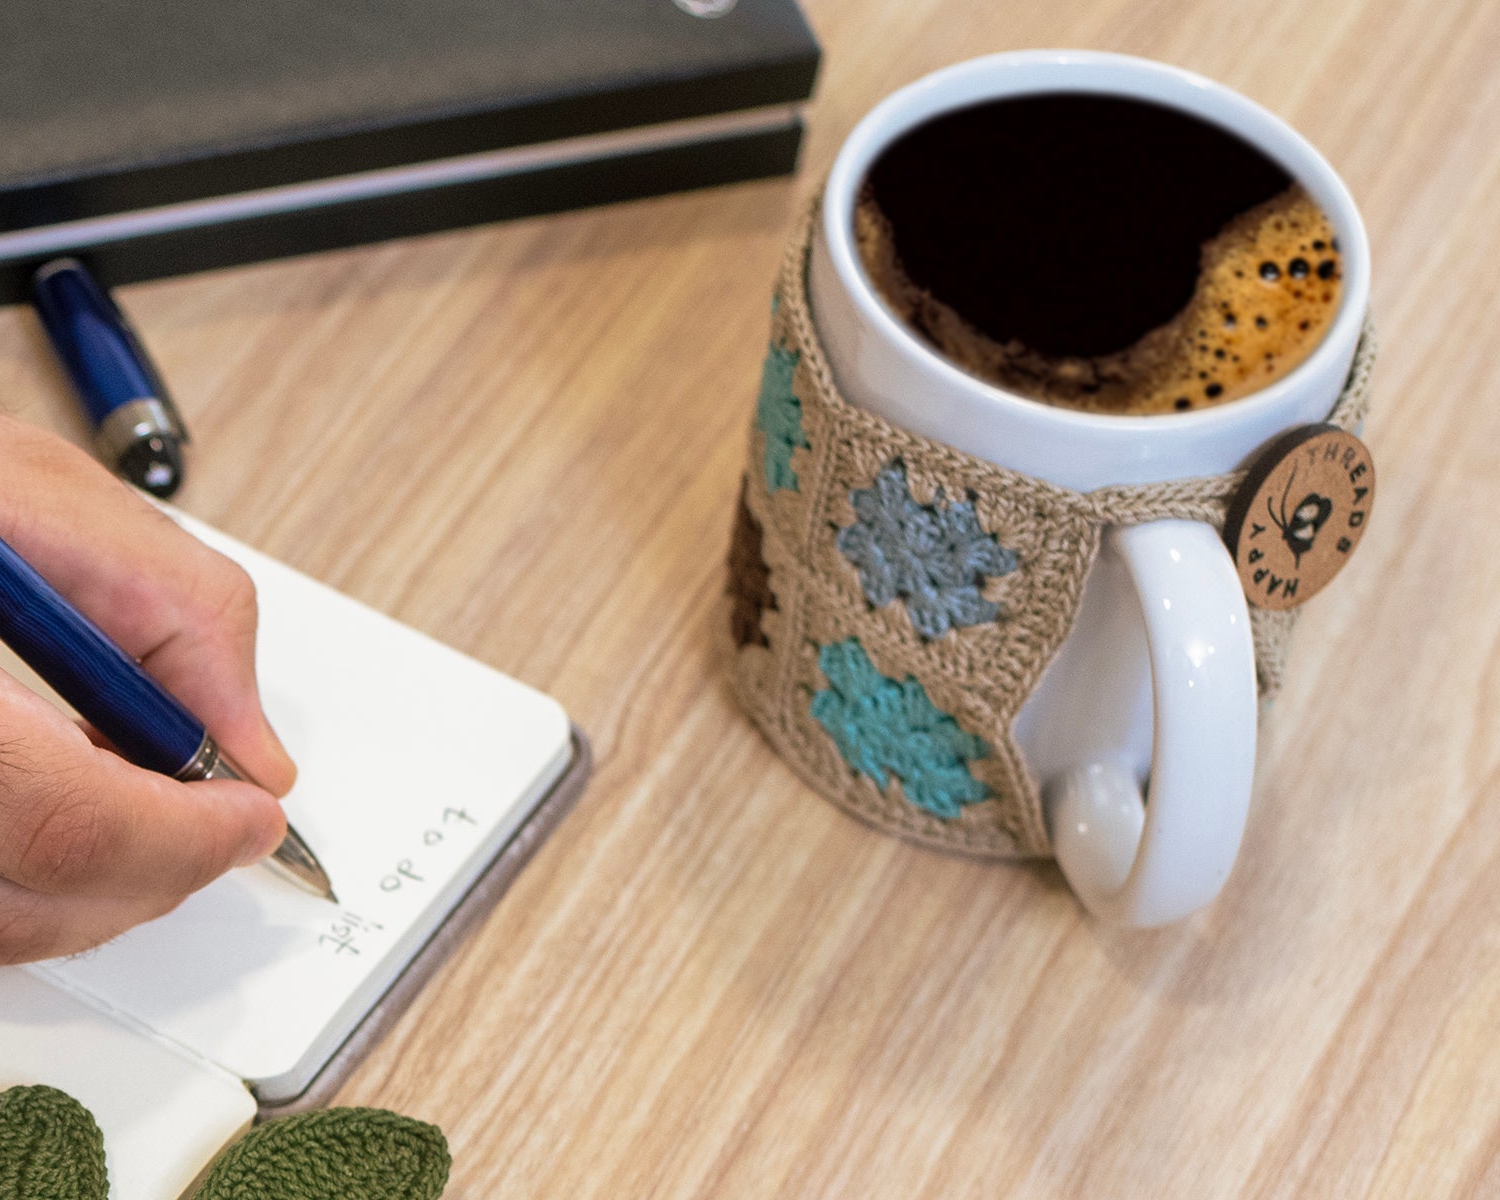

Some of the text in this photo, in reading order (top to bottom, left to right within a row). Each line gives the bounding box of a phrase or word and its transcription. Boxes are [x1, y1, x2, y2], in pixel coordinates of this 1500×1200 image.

[1248, 522, 1298, 598] HAPPY
[423, 806, 477, 847] to
[379, 858, 424, 892] do
